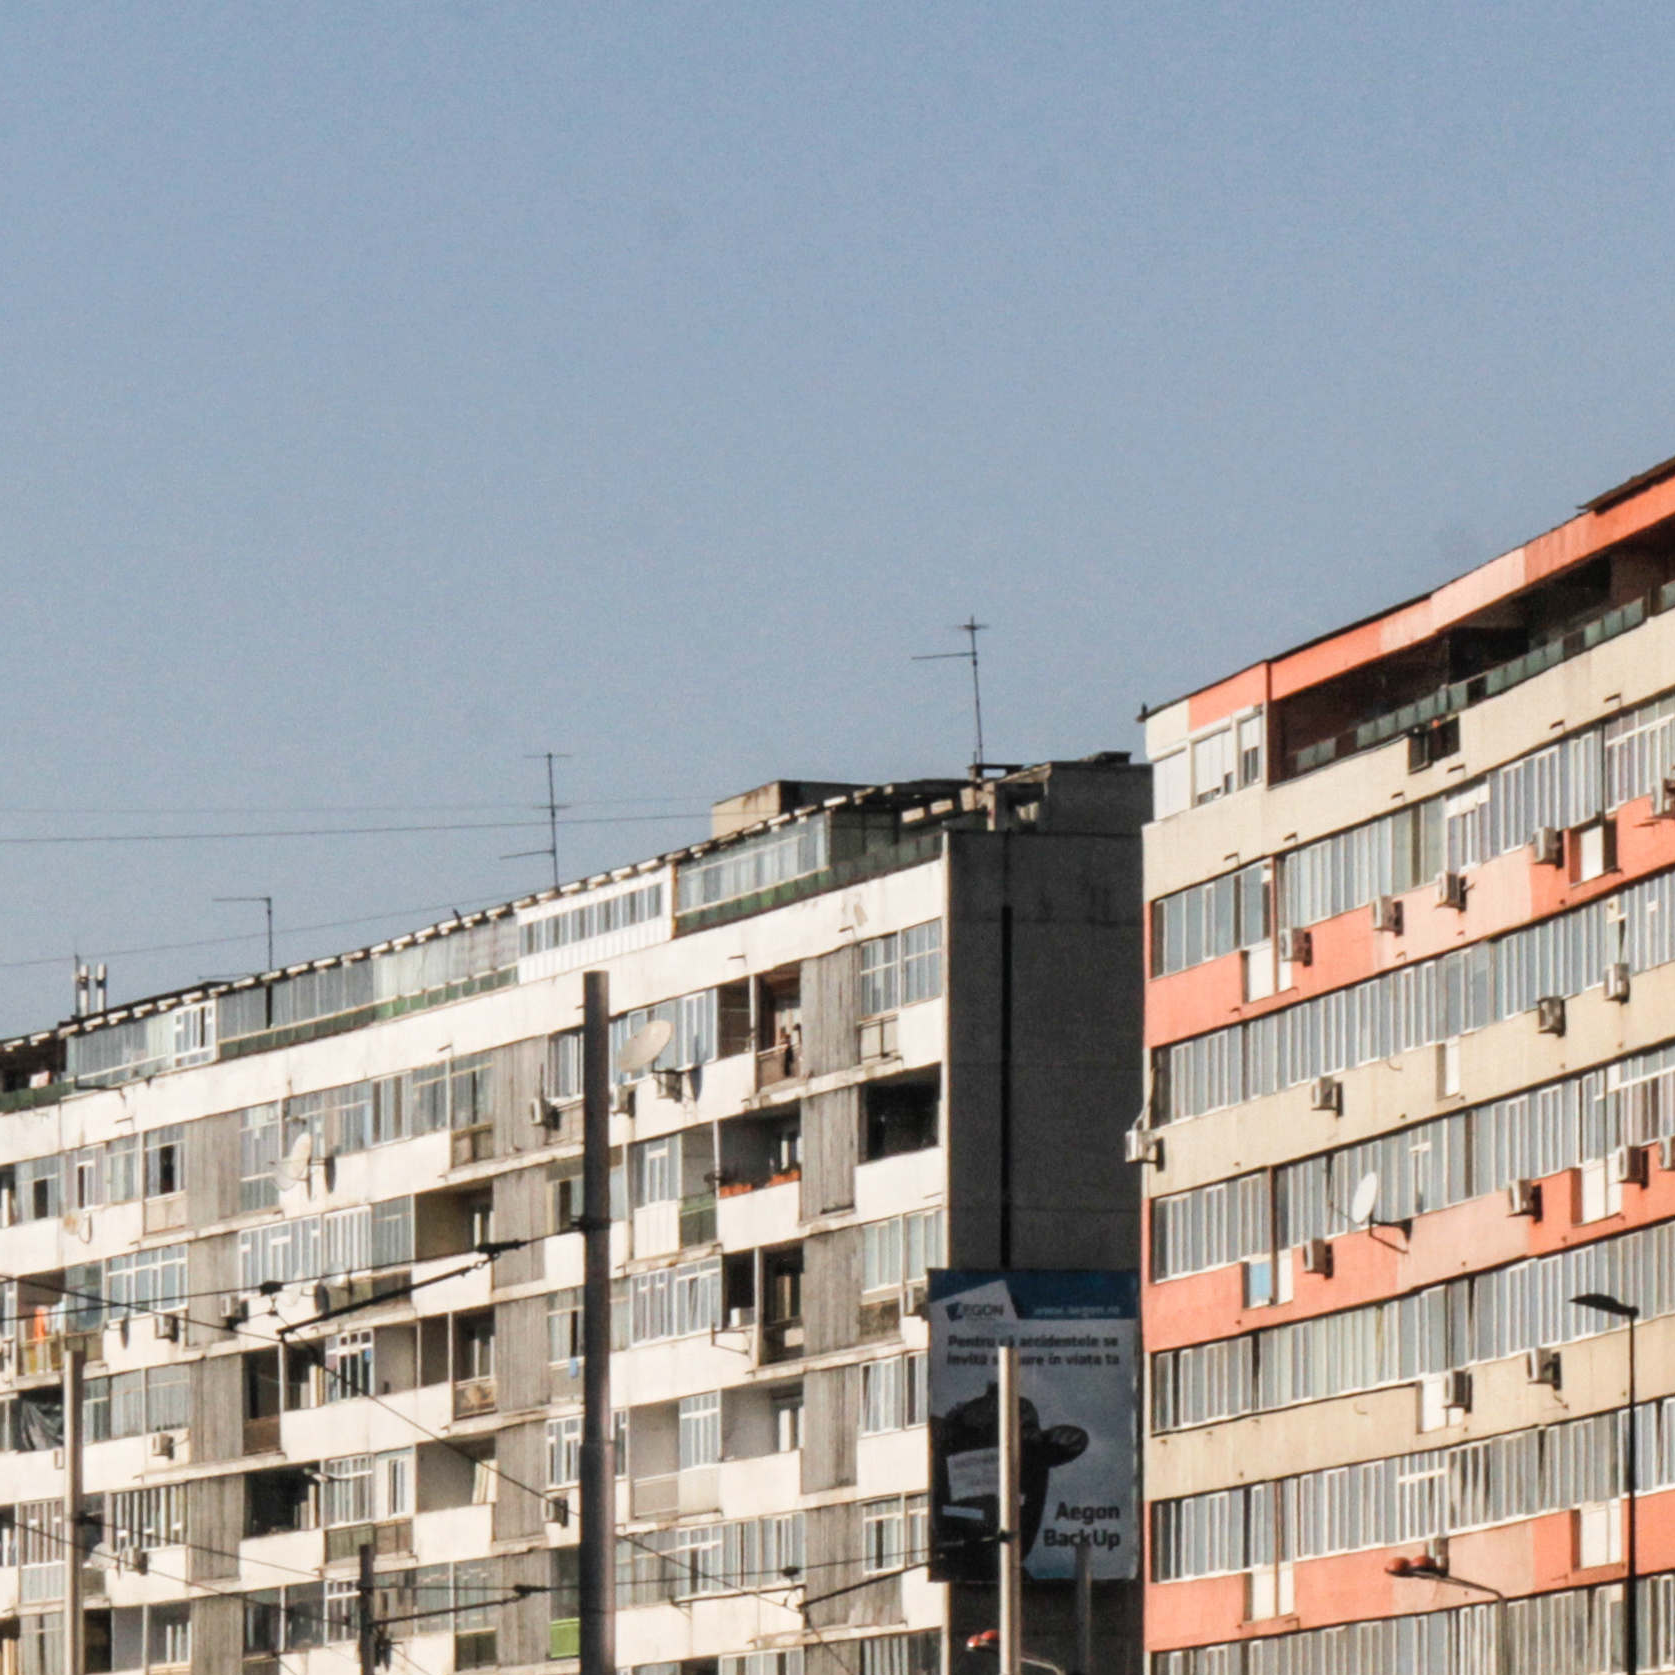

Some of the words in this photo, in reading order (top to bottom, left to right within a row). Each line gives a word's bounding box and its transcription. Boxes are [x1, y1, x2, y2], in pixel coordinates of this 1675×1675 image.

[947, 1334, 996, 1348] Pentru
[1020, 1334, 1099, 1348] accidentele
[1103, 1337, 1119, 1348] se
[1104, 1353, 1121, 1366] ta
[1055, 1502, 1121, 1527] Aegon
[1043, 1530, 1121, 1551] BackUp
